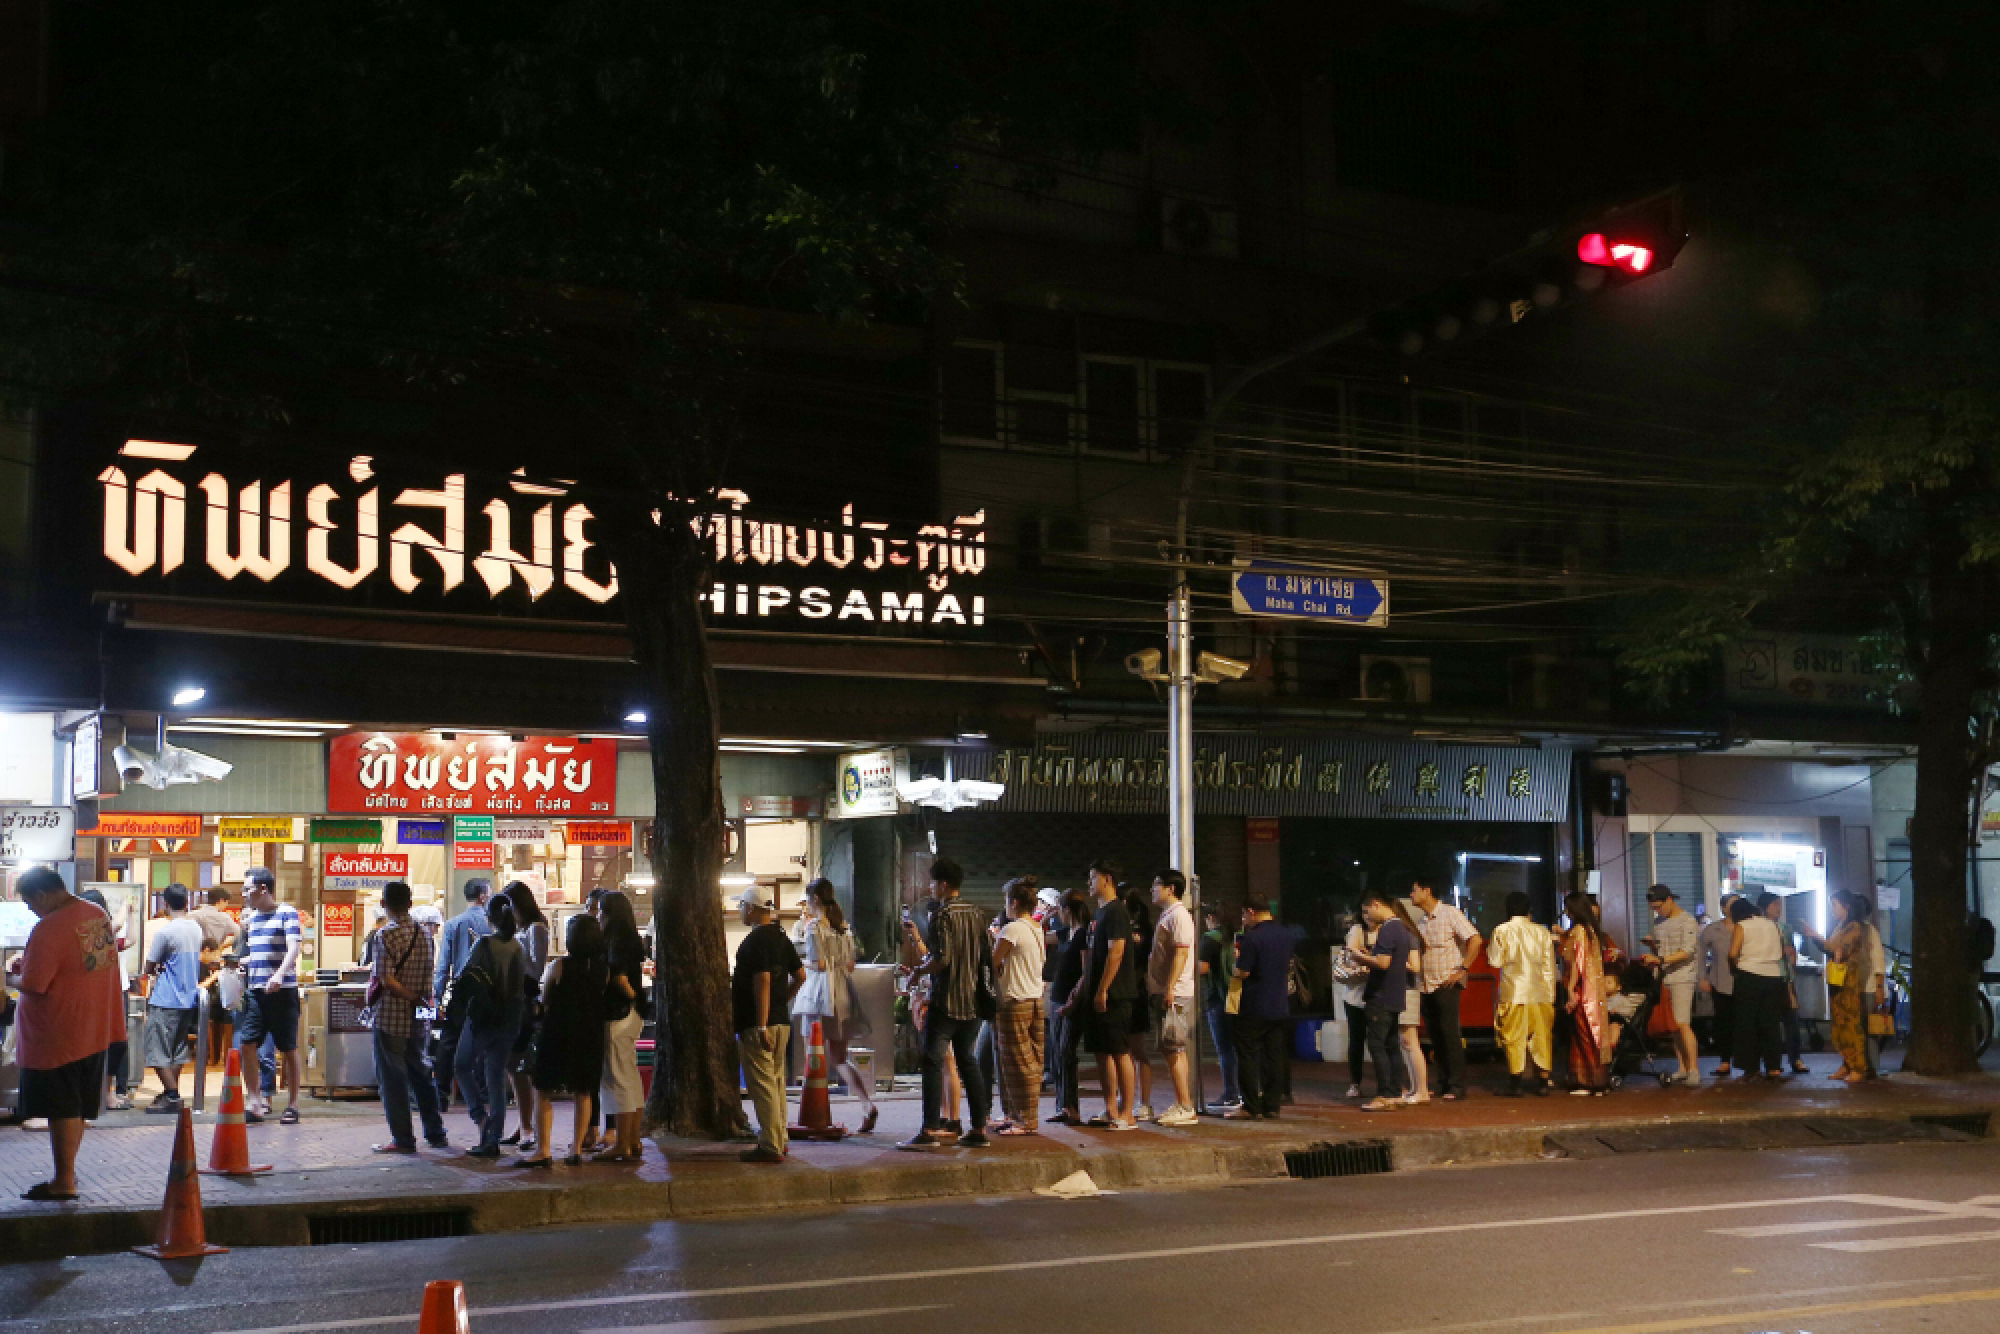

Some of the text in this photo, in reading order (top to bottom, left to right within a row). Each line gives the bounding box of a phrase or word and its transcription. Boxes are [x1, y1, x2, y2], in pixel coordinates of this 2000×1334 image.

[97, 438, 619, 605] ทิพย์สมัย
[1265, 596, 1295, 610] Maha
[1303, 600, 1327, 613] Chai
[359, 737, 592, 793] ทิพย์สมัย
[334, 878, 358, 887] Take
